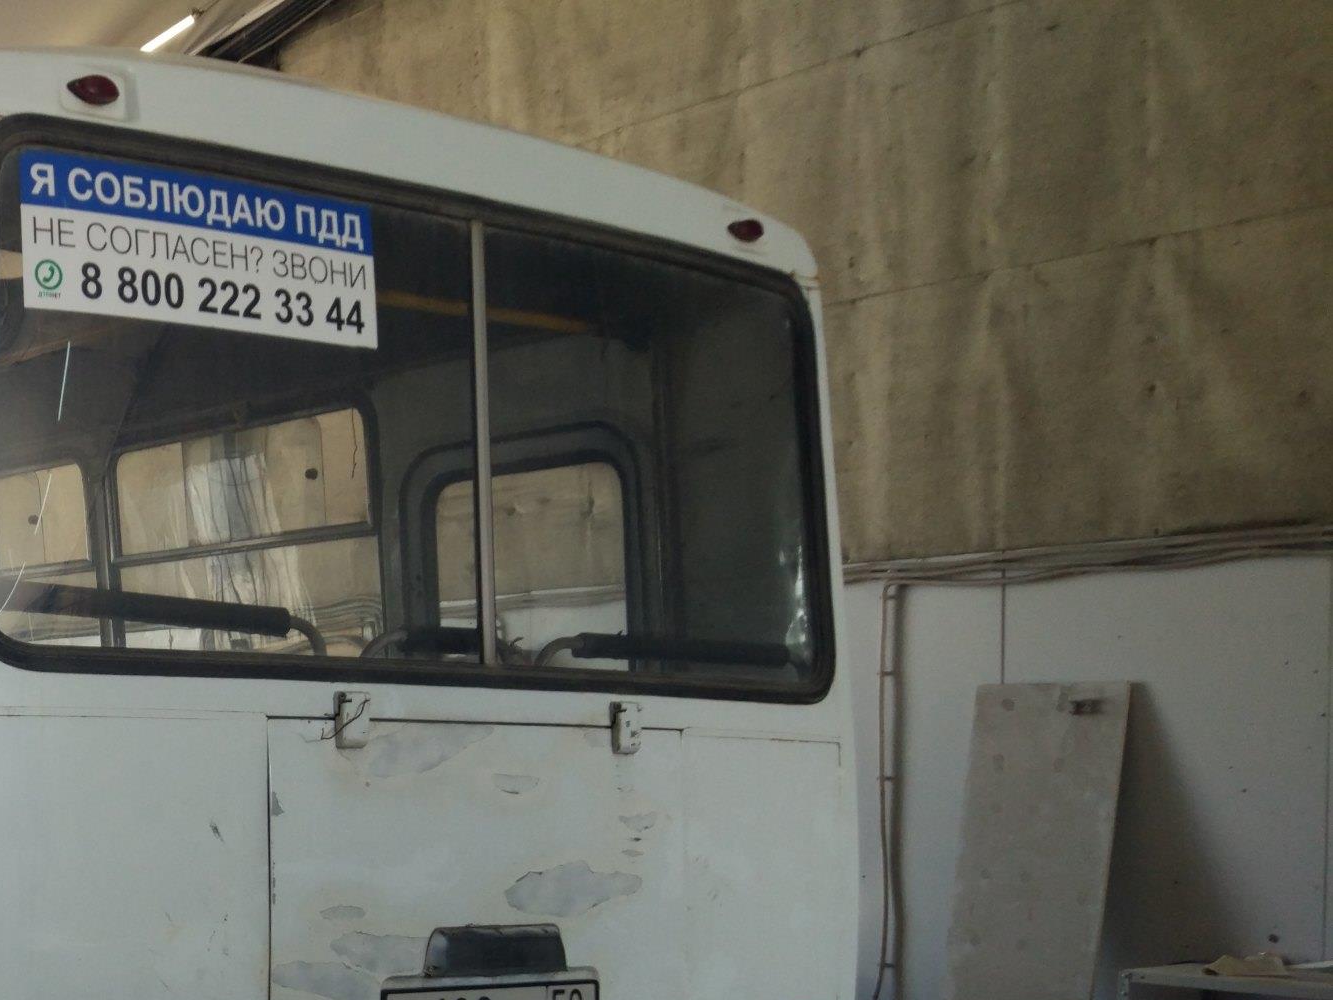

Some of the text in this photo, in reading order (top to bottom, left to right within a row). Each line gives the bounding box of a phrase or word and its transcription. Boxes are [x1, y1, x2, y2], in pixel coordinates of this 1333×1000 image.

[30, 163, 364, 250] Я СОБЛЮДАЮ ПДД
[33, 217, 367, 289] НЕ СОГЛАСЕН? ЗВОНИ
[81, 262, 365, 334] 8 800 222 33 44
